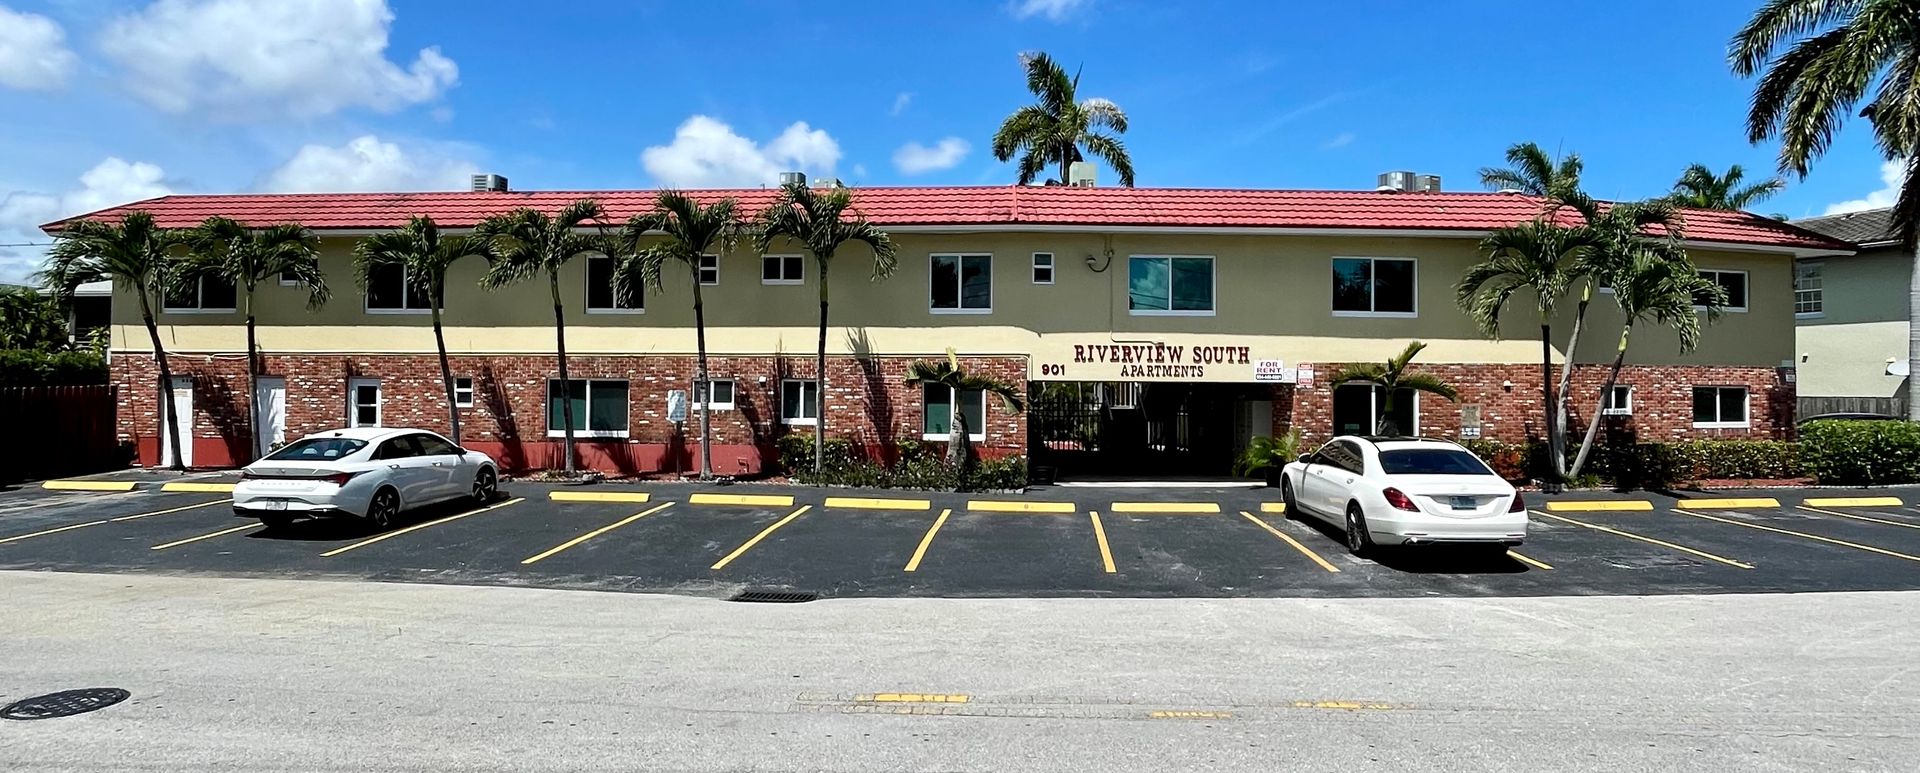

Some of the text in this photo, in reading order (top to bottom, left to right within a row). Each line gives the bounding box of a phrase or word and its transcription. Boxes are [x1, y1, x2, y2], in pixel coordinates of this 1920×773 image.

[1074, 345, 1250, 364] RIVERVIEW SOUTH
[1041, 364, 1065, 376] 901
[1120, 365, 1204, 377] APARTMENTS
